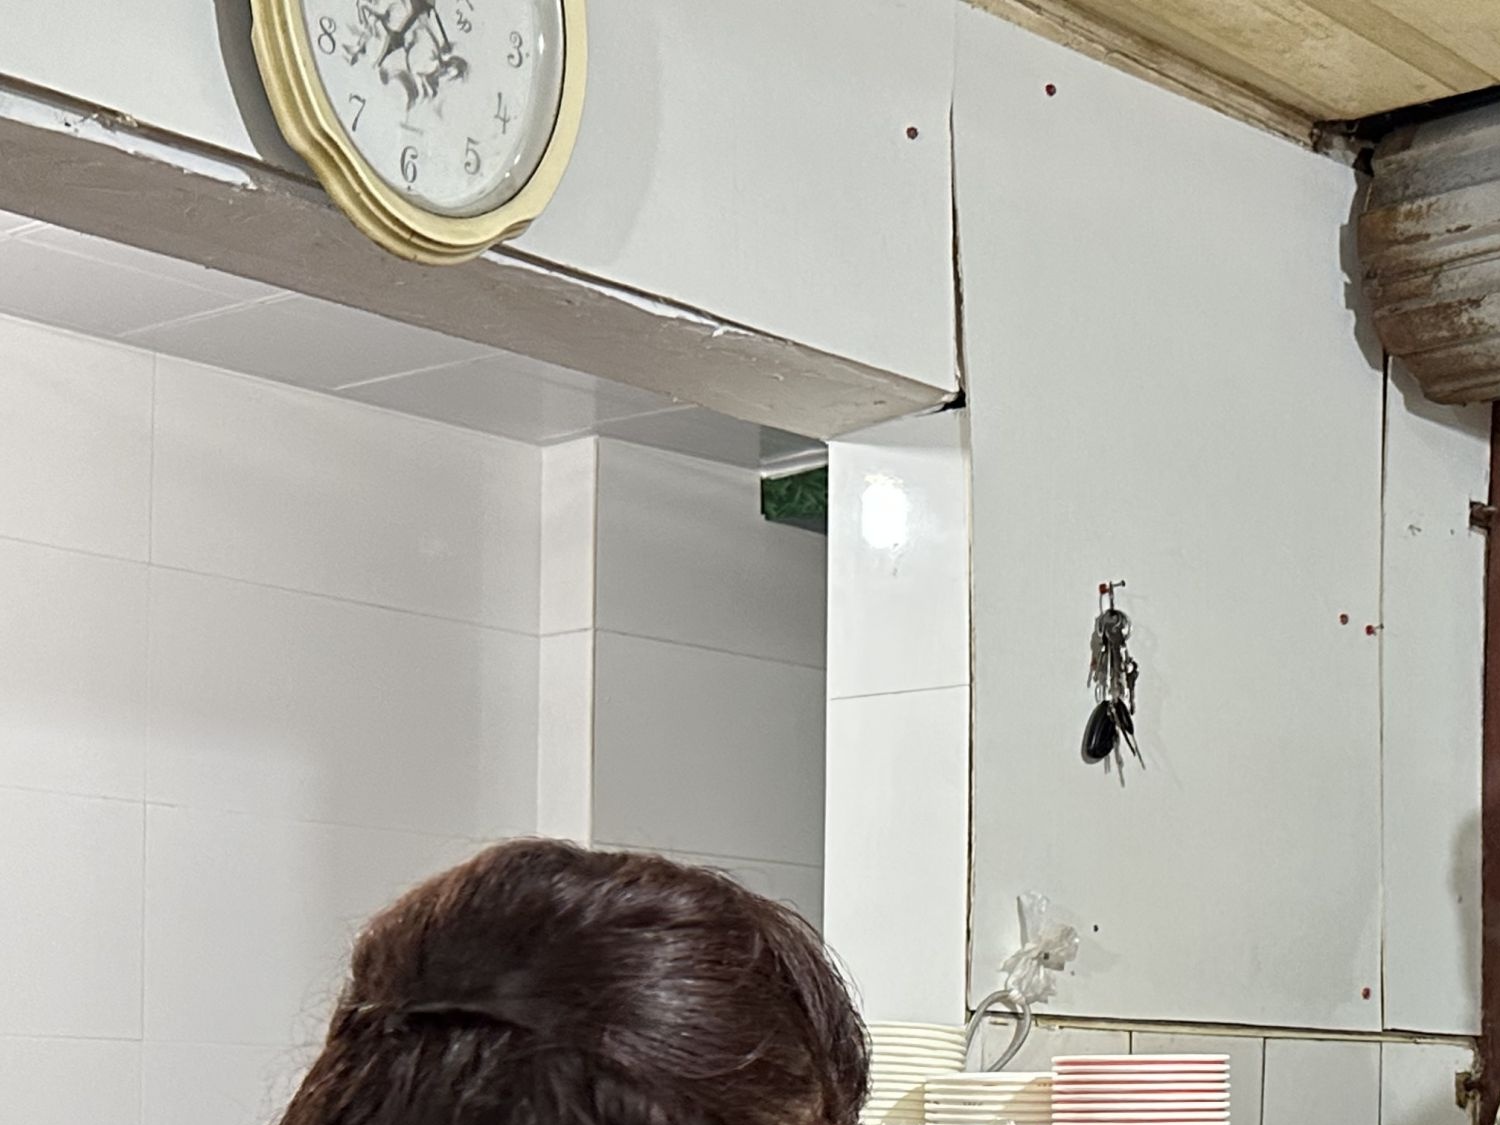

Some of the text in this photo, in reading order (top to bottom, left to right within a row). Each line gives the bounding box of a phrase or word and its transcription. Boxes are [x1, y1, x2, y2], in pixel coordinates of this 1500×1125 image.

[318, 16, 337, 55] 8
[507, 31, 523, 68] 3
[348, 93, 366, 132] 7
[494, 92, 511, 135] 4
[400, 145, 418, 183] 6
[464, 137, 481, 175] 5
